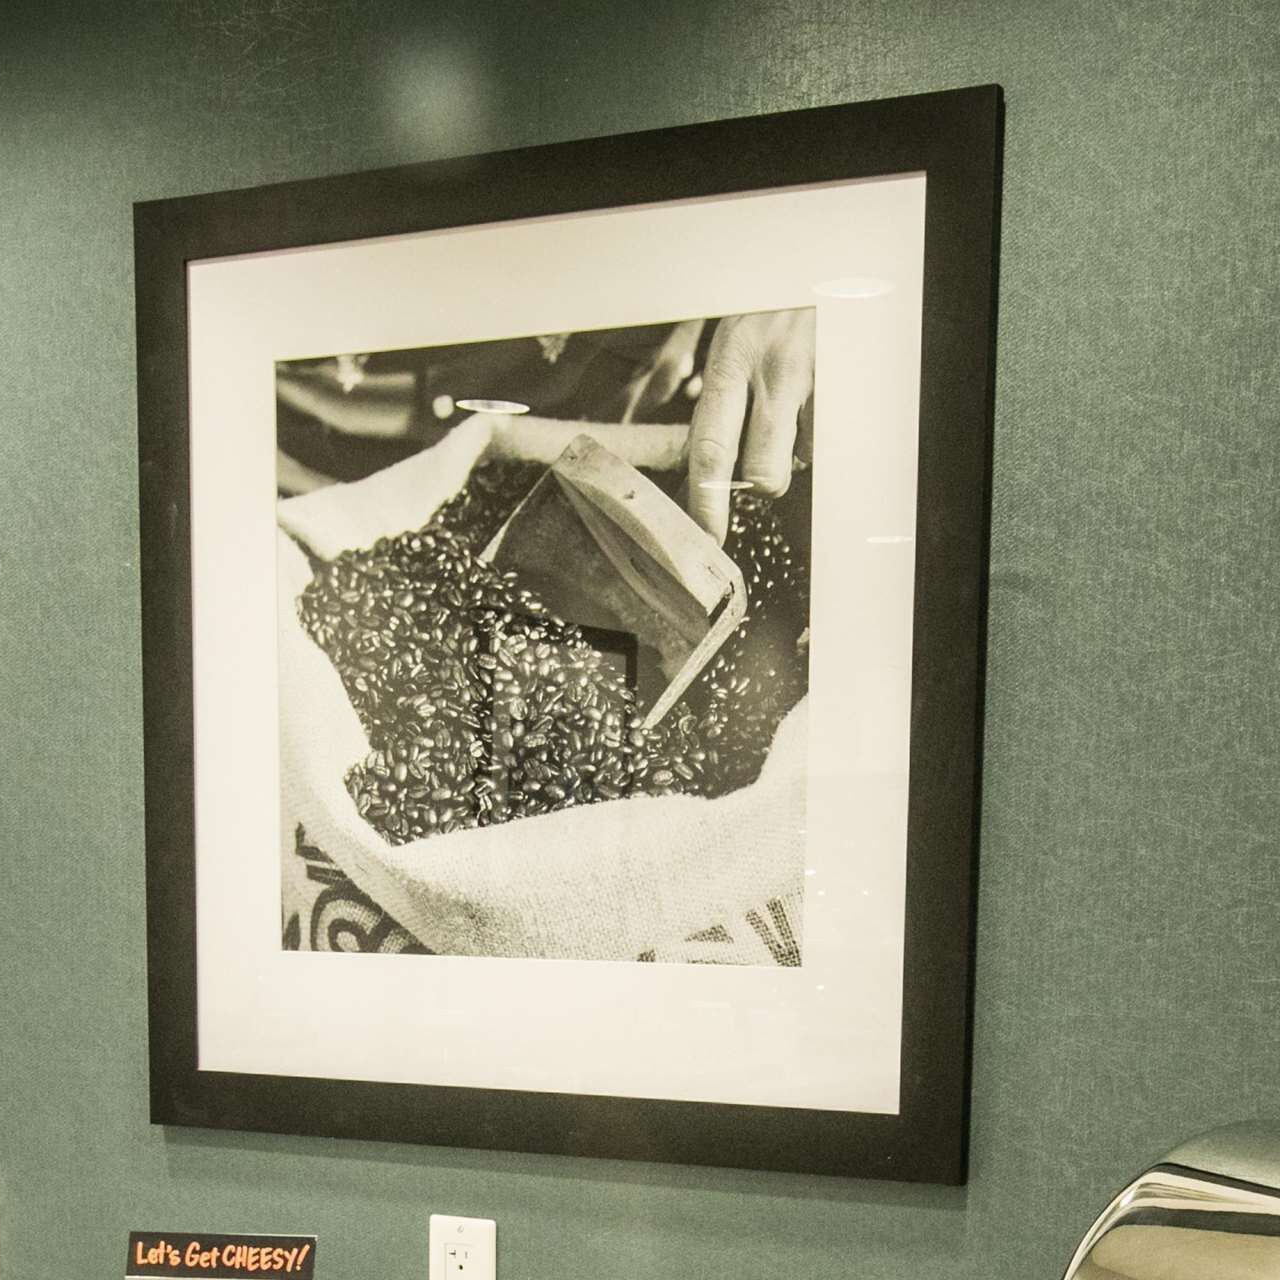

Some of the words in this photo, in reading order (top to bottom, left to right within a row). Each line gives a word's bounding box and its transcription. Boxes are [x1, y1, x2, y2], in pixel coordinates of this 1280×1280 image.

[136, 1240, 181, 1266] Let's
[185, 1241, 220, 1268] Get
[222, 1244, 310, 1272] CHEESY!
